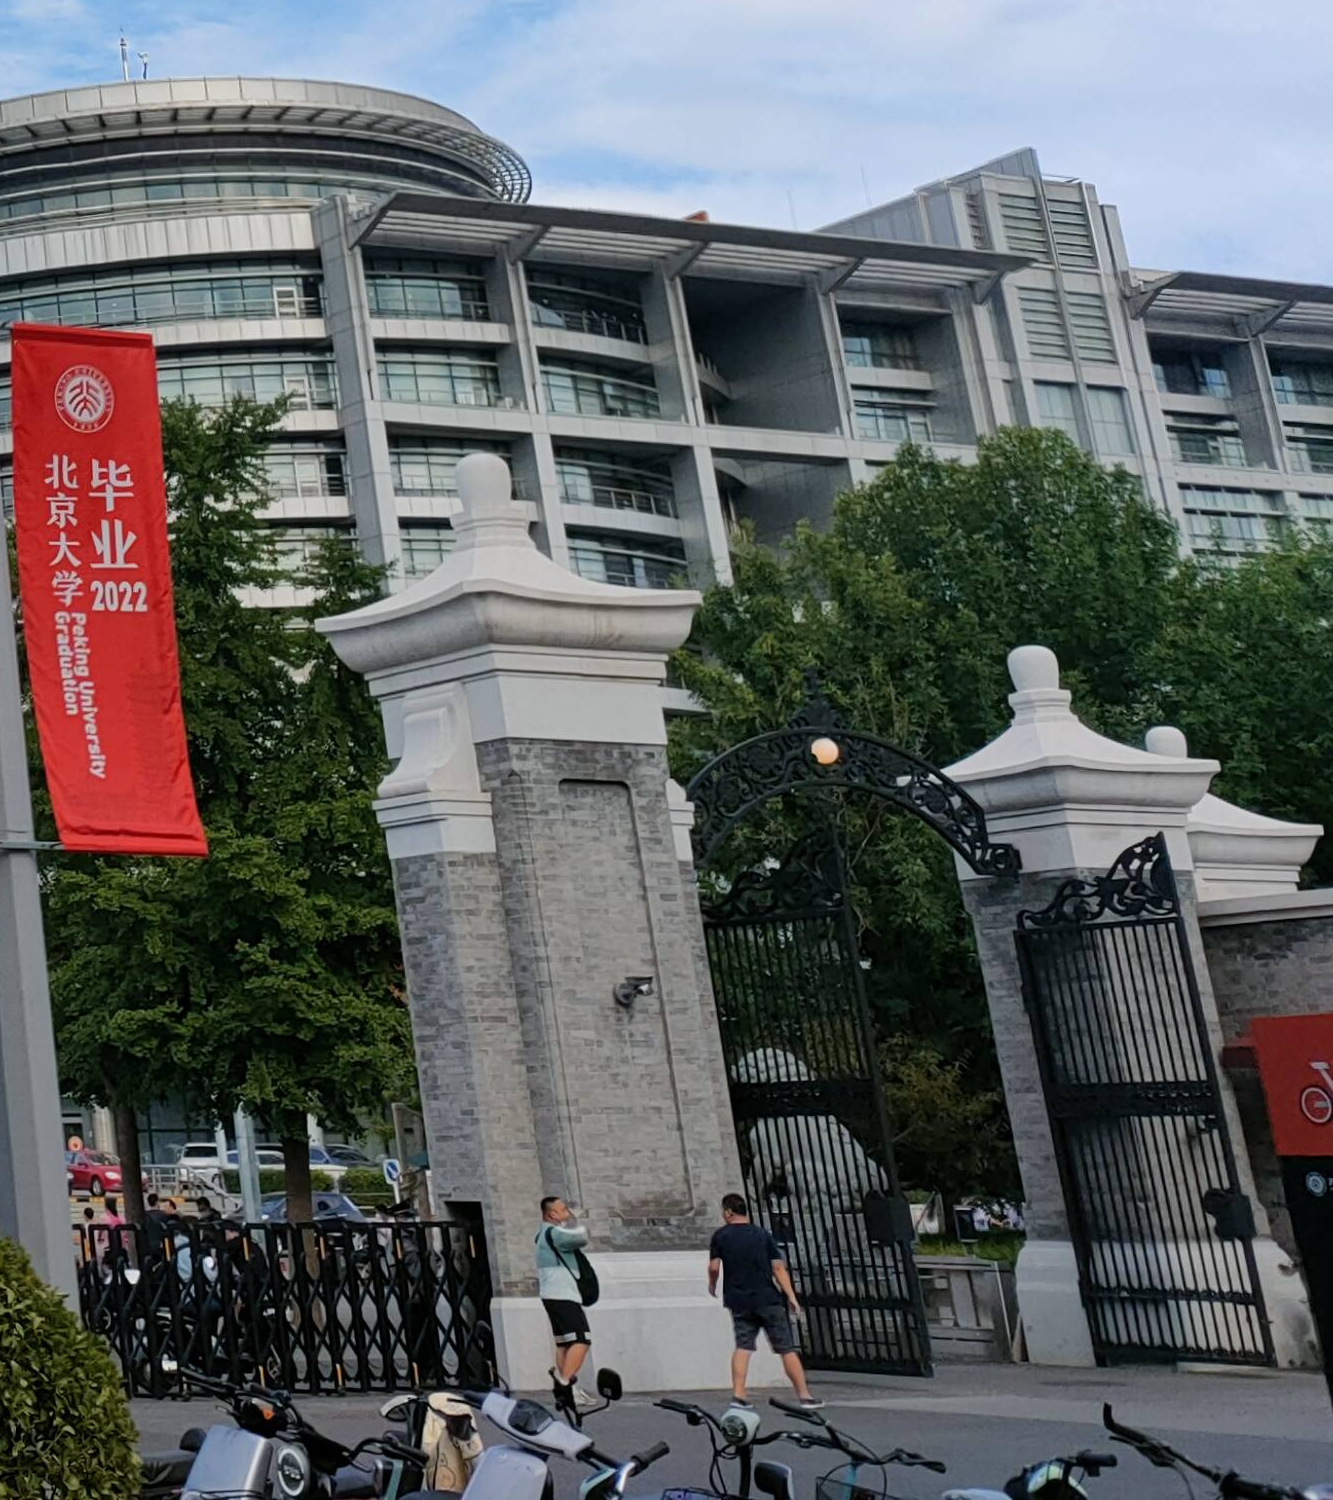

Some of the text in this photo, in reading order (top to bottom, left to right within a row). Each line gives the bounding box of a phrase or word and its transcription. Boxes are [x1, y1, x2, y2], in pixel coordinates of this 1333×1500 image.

[44, 454, 84, 607] 北京大学
[89, 458, 148, 612] 毕业 2022
[54, 611, 79, 716] Graduation
[71, 612, 106, 779] Peking University
